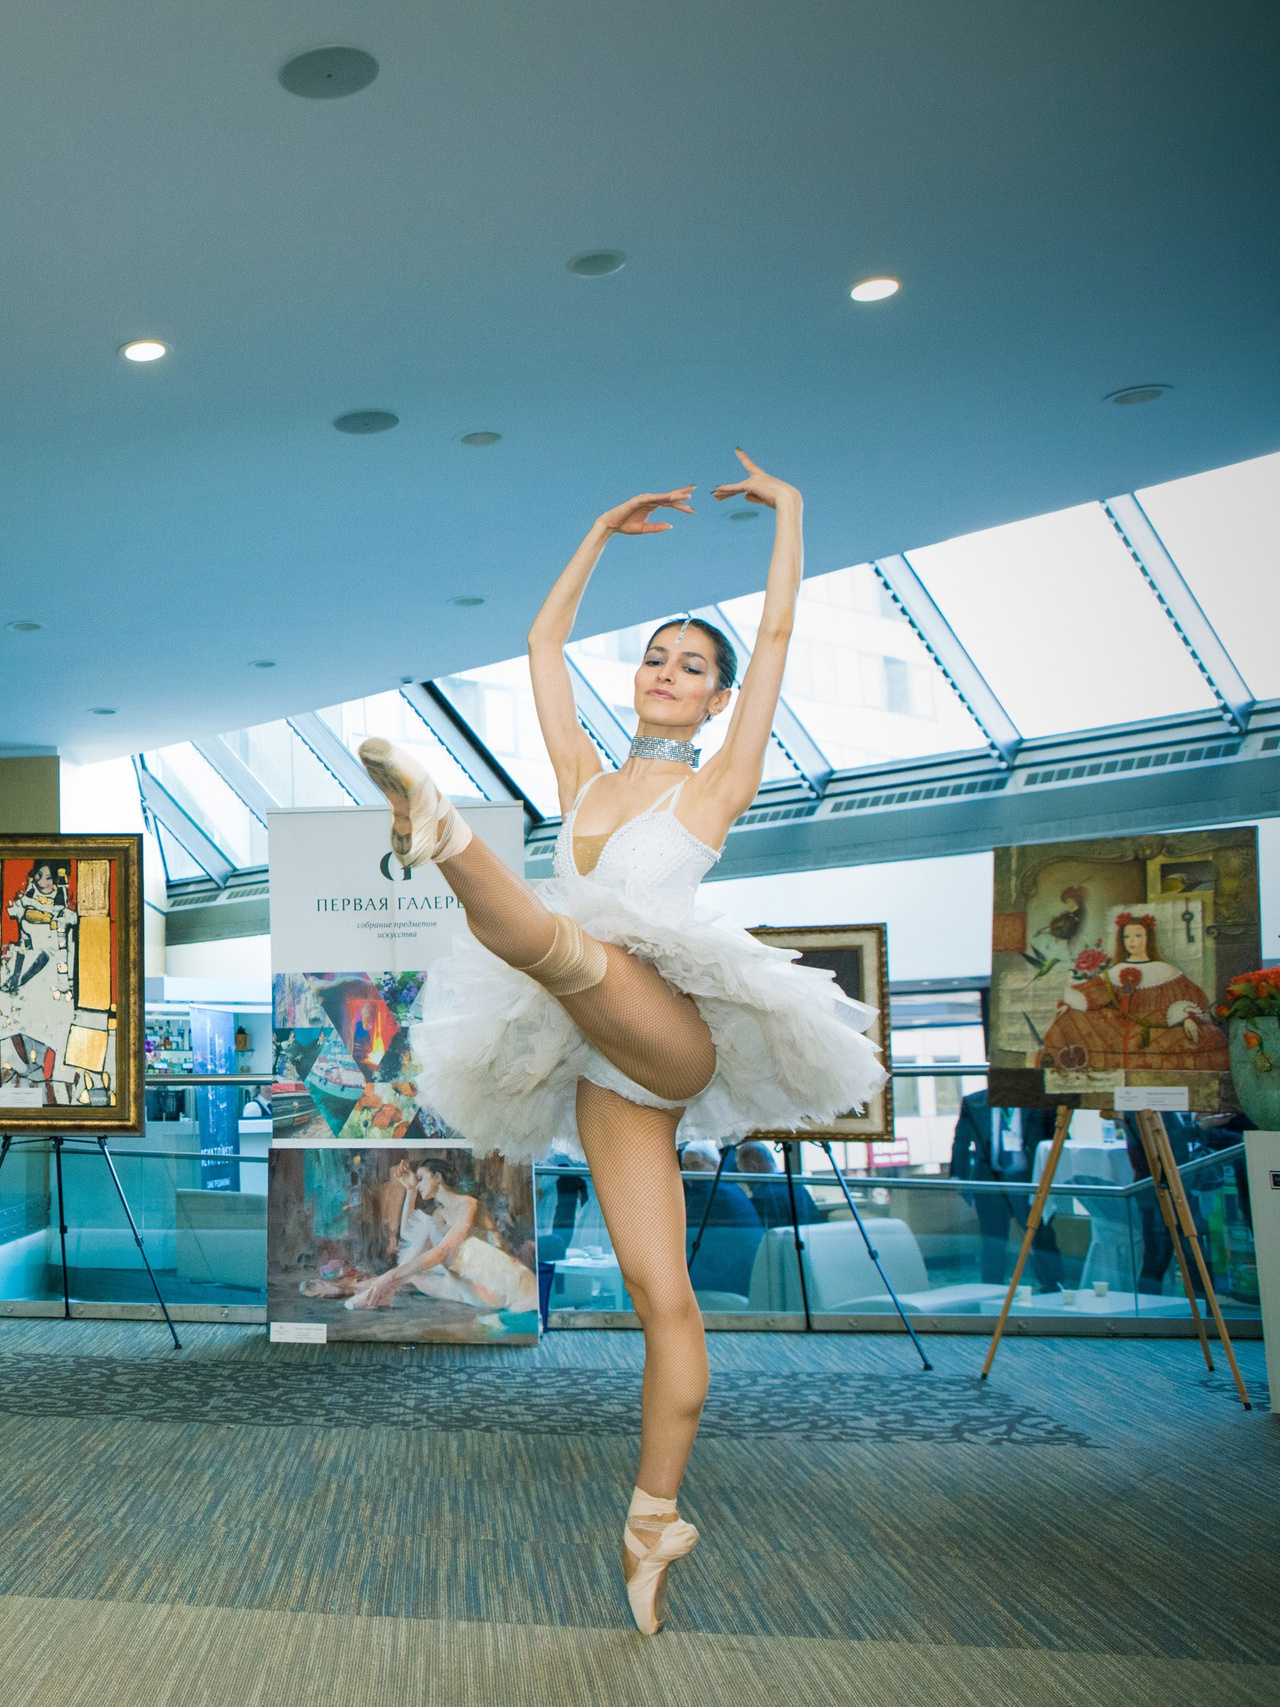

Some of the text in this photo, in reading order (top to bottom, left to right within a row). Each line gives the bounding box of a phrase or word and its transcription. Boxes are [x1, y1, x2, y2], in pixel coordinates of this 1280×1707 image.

[317, 897, 388, 912] ПЕРВАЯ
[357, 920, 437, 929] собрание предметов
[377, 931, 417, 939] искусства
